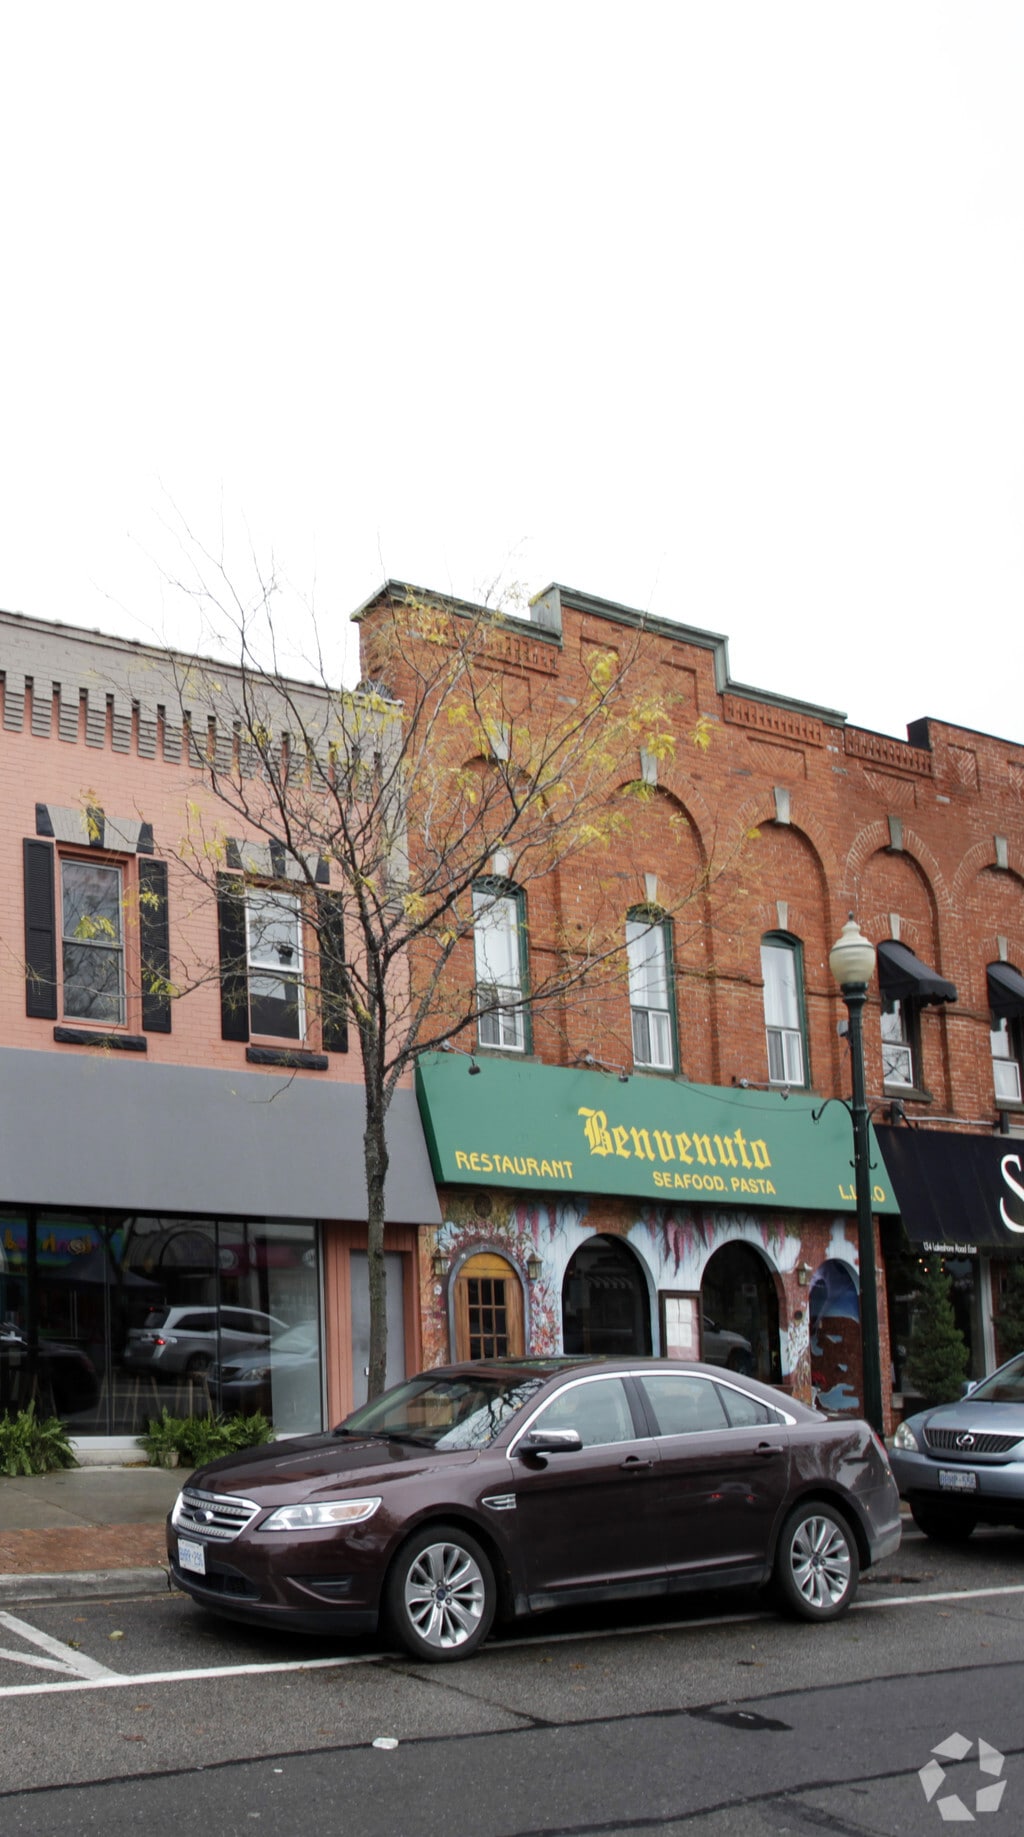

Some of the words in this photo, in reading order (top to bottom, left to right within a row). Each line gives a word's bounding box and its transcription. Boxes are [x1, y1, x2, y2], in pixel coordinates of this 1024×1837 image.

[578, 1107, 772, 1170] Benvenuto
[455, 1150, 574, 1179] RESTAURANT
[731, 1177, 777, 1195] PASTA
[955, 1243, 967, 1254] Road
